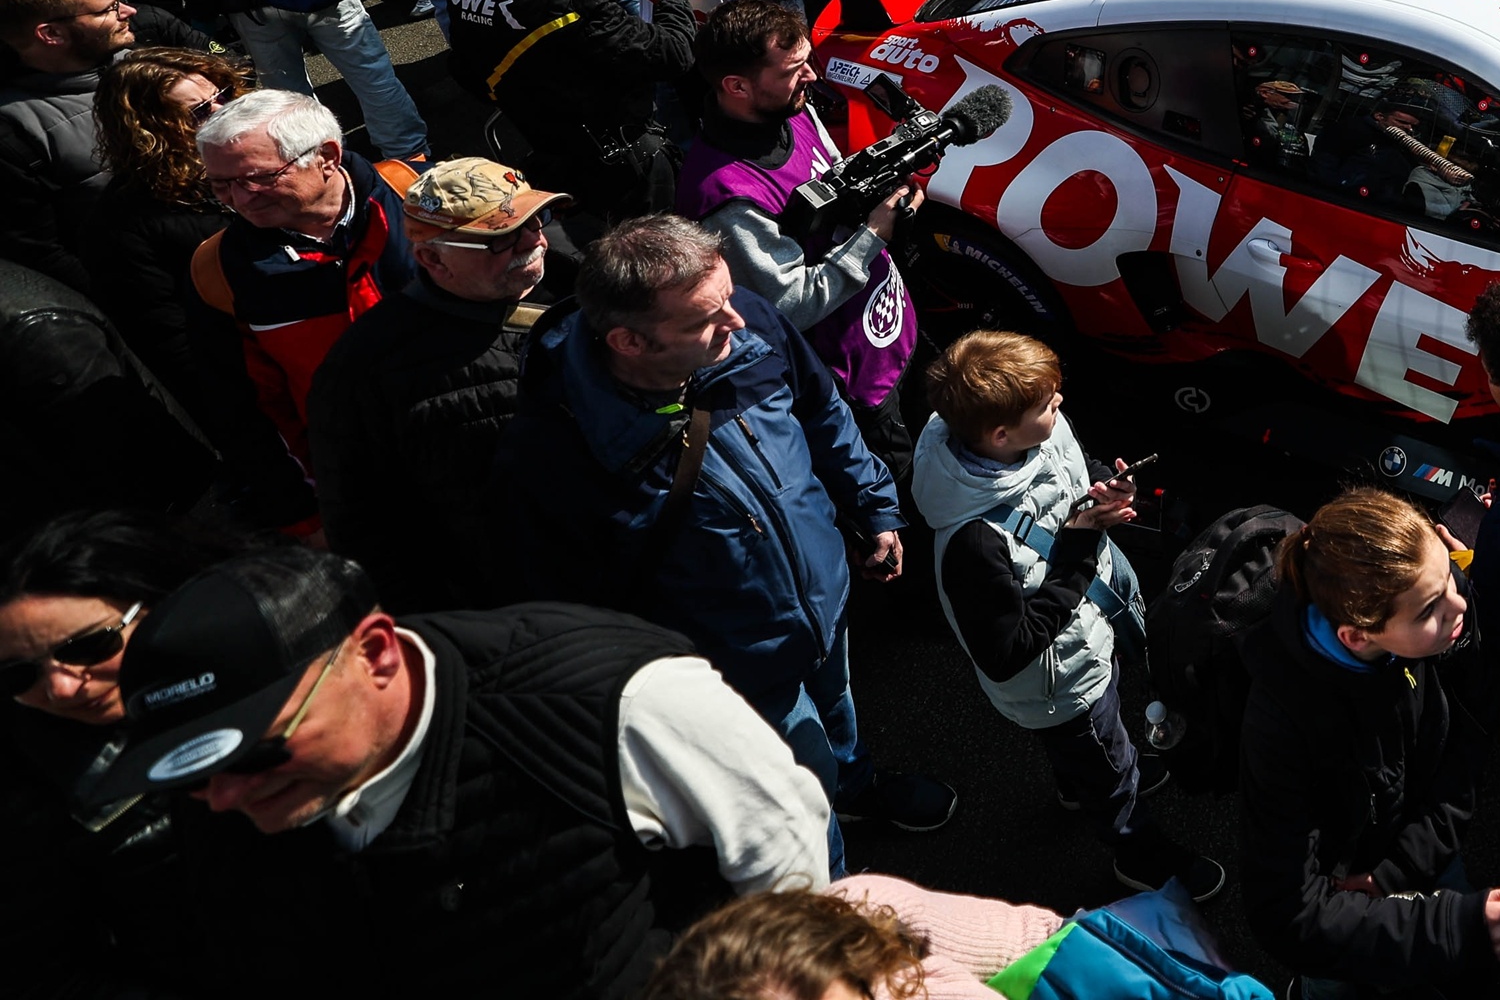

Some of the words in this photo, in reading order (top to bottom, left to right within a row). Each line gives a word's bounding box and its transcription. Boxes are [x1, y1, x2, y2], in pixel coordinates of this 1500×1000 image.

[461, 10, 494, 27] RACING
[883, 35, 919, 49] sport
[870, 44, 940, 74] auto
[926, 55, 1482, 424] ROWE
[966, 245, 1048, 315] MICHELIN
[1430, 468, 1455, 488] M
[144, 671, 216, 705] MORELO
